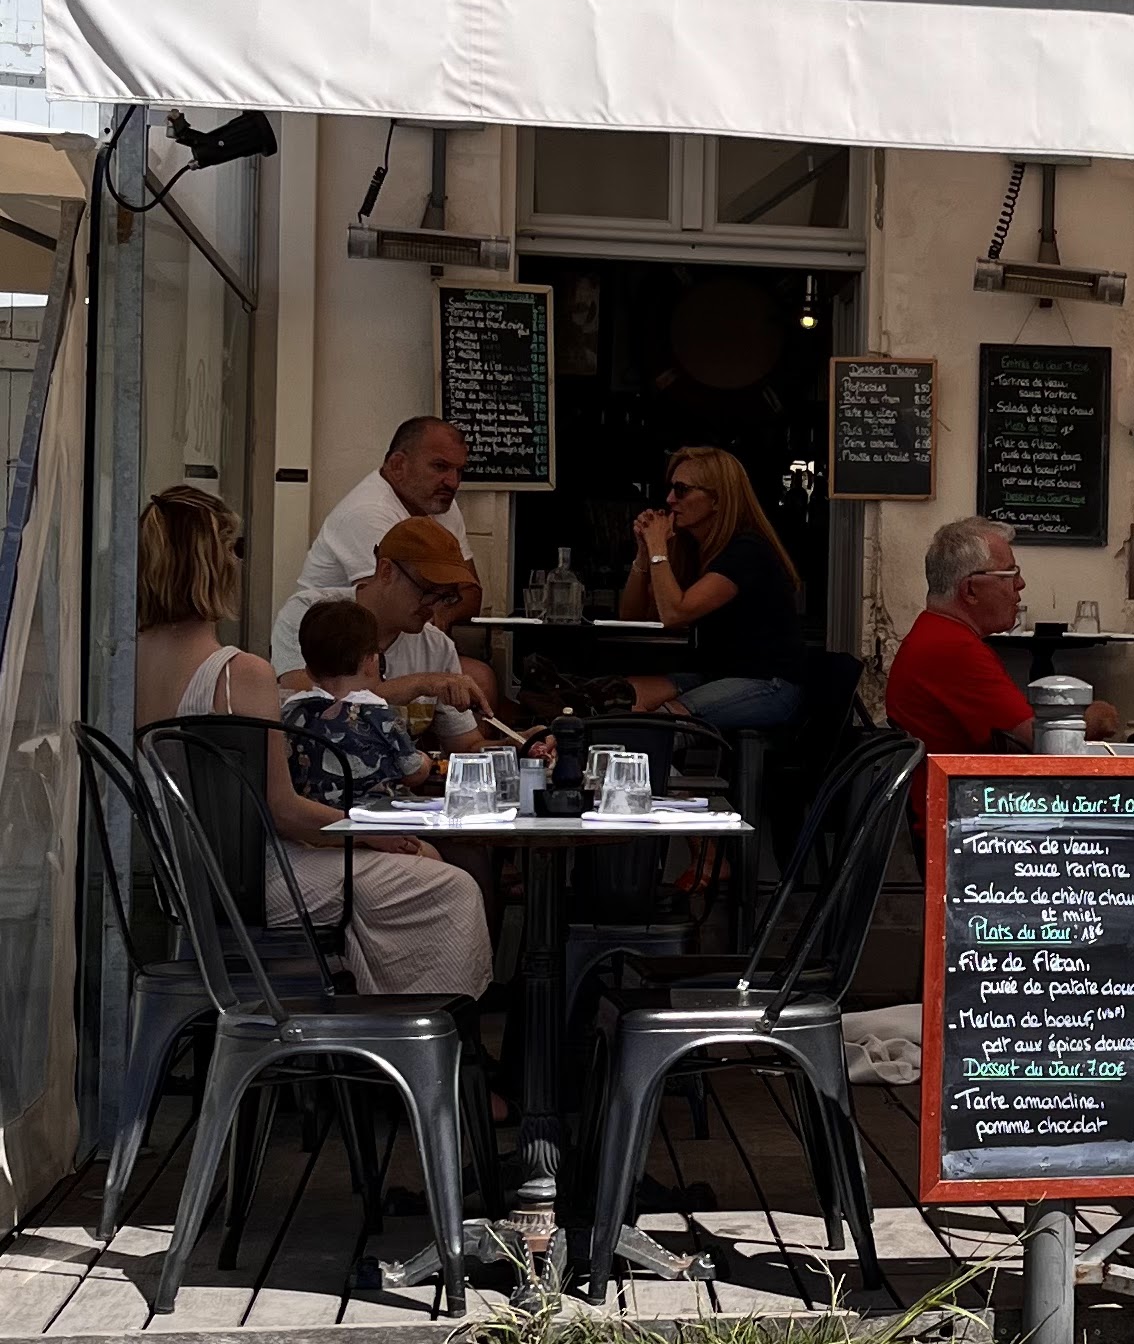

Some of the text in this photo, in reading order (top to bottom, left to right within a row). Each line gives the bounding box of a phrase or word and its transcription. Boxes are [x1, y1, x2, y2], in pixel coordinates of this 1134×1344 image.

[985, 787, 1048, 813] Entrées
[1052, 795, 1069, 813] du
[963, 832, 1034, 854] Tartines
[1040, 837, 1059, 854] de
[1015, 860, 1130, 878] sauce tartare
[964, 883, 1028, 903] Salade
[1031, 887, 1050, 904] de
[1052, 886, 1097, 905] chèvre
[1042, 907, 1058, 922] et
[969, 915, 1013, 940] Plats
[1017, 924, 1035, 940] du
[959, 950, 998, 972] Filet
[1002, 952, 1026, 972] de
[980, 977, 1019, 1003] purée
[1024, 978, 1044, 995] de
[1049, 979, 1098, 1001] patate
[960, 1008, 1016, 1028] Merlan
[1021, 1011, 1042, 1028] de
[1015, 1039, 1042, 1052] aux
[1048, 1033, 1092, 1058] épices
[963, 1058, 1020, 1077] Dessert
[1025, 1059, 1042, 1076] du
[954, 1087, 1010, 1110] Tarte
[976, 1120, 1034, 1142] pomme
